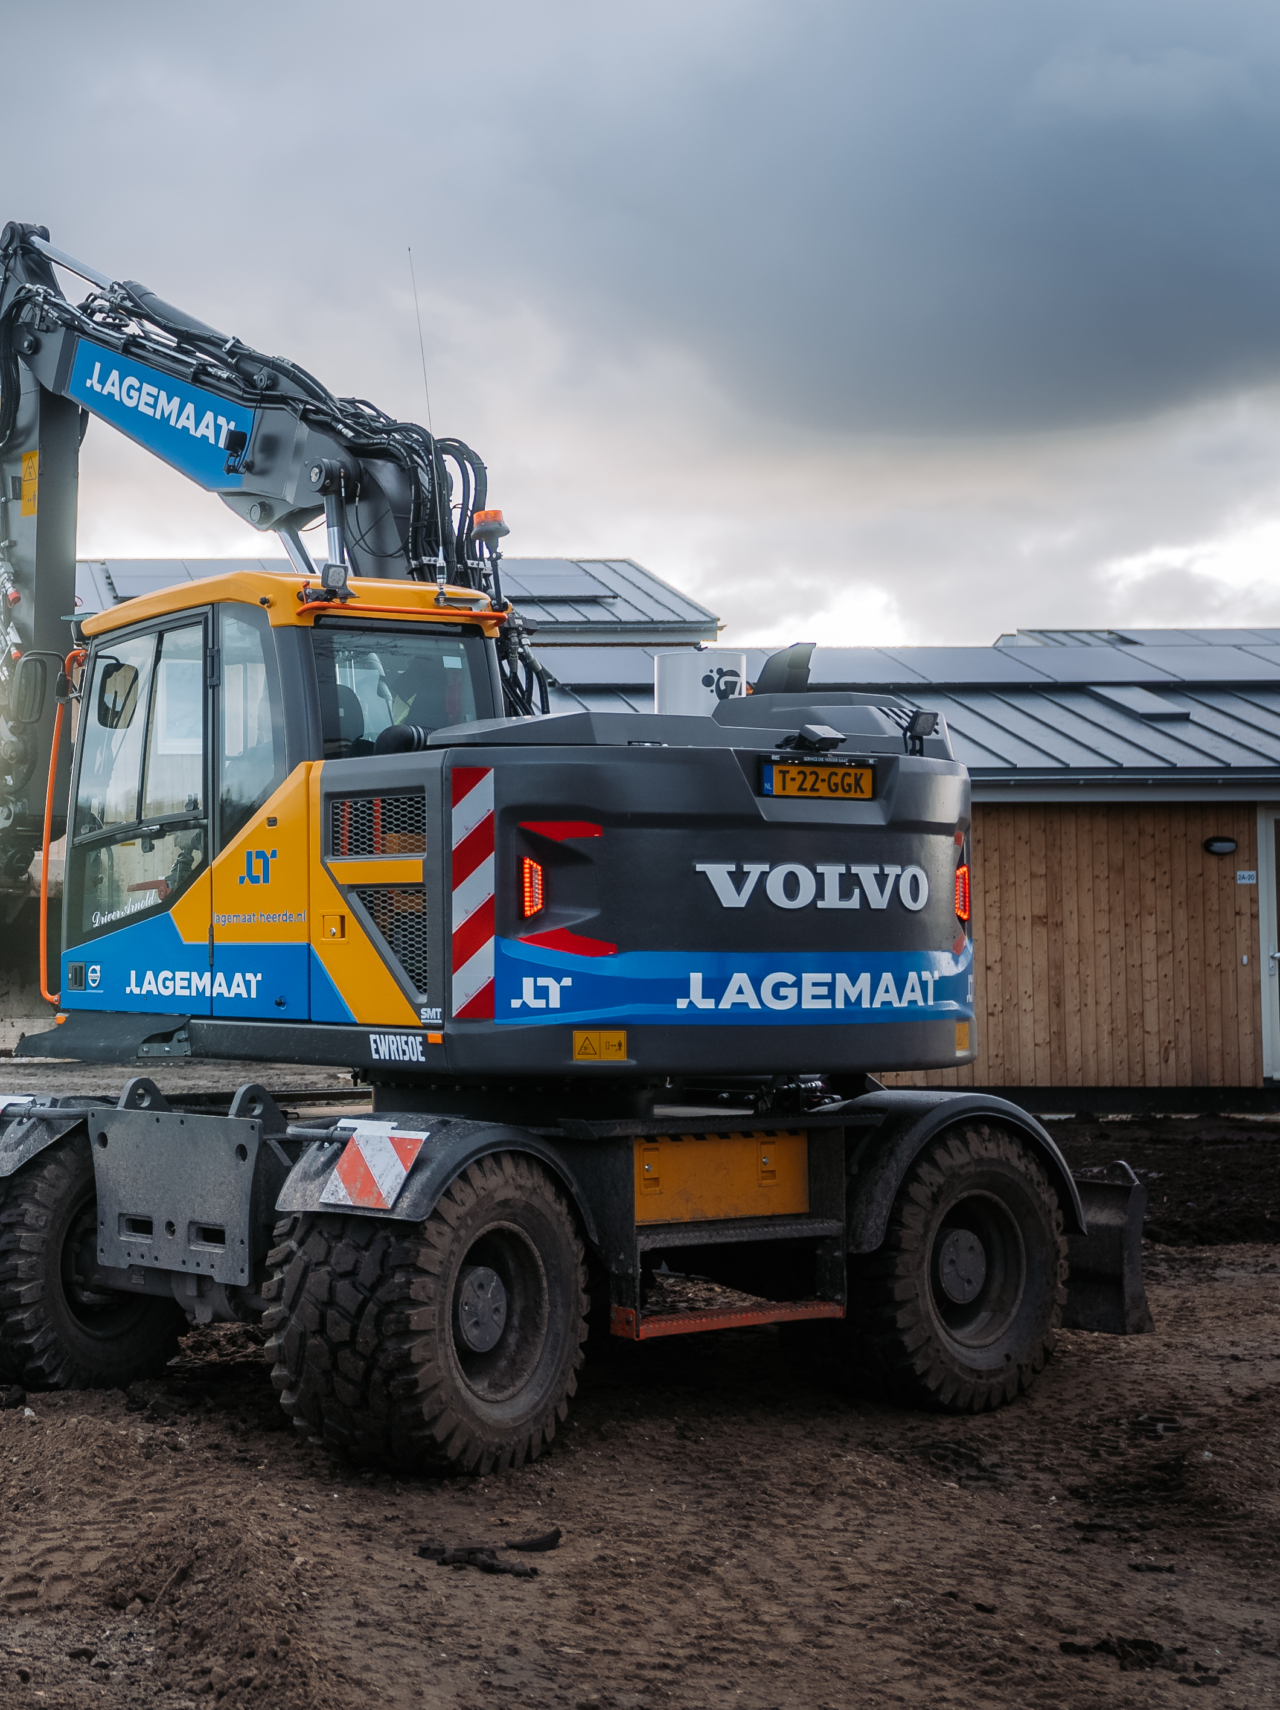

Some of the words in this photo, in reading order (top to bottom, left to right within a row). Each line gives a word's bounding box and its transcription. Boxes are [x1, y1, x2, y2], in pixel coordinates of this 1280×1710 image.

[85, 361, 235, 449] LAGEMAAT
[764, 782, 773, 790] NL
[778, 769, 865, 794] T-22-GGK
[694, 862, 929, 911] VOLVO
[1238, 873, 1255, 881] 2A-20
[91, 911, 121, 928] Driver
[121, 889, 156, 917] Arnold
[213, 910, 306, 926] lagemaat-heerde.nl
[125, 970, 262, 999] LAGEMAAT
[676, 970, 939, 1010] LAGEMAAT
[420, 1007, 442, 1019] SMT
[369, 1033, 426, 1062] EWR150E
